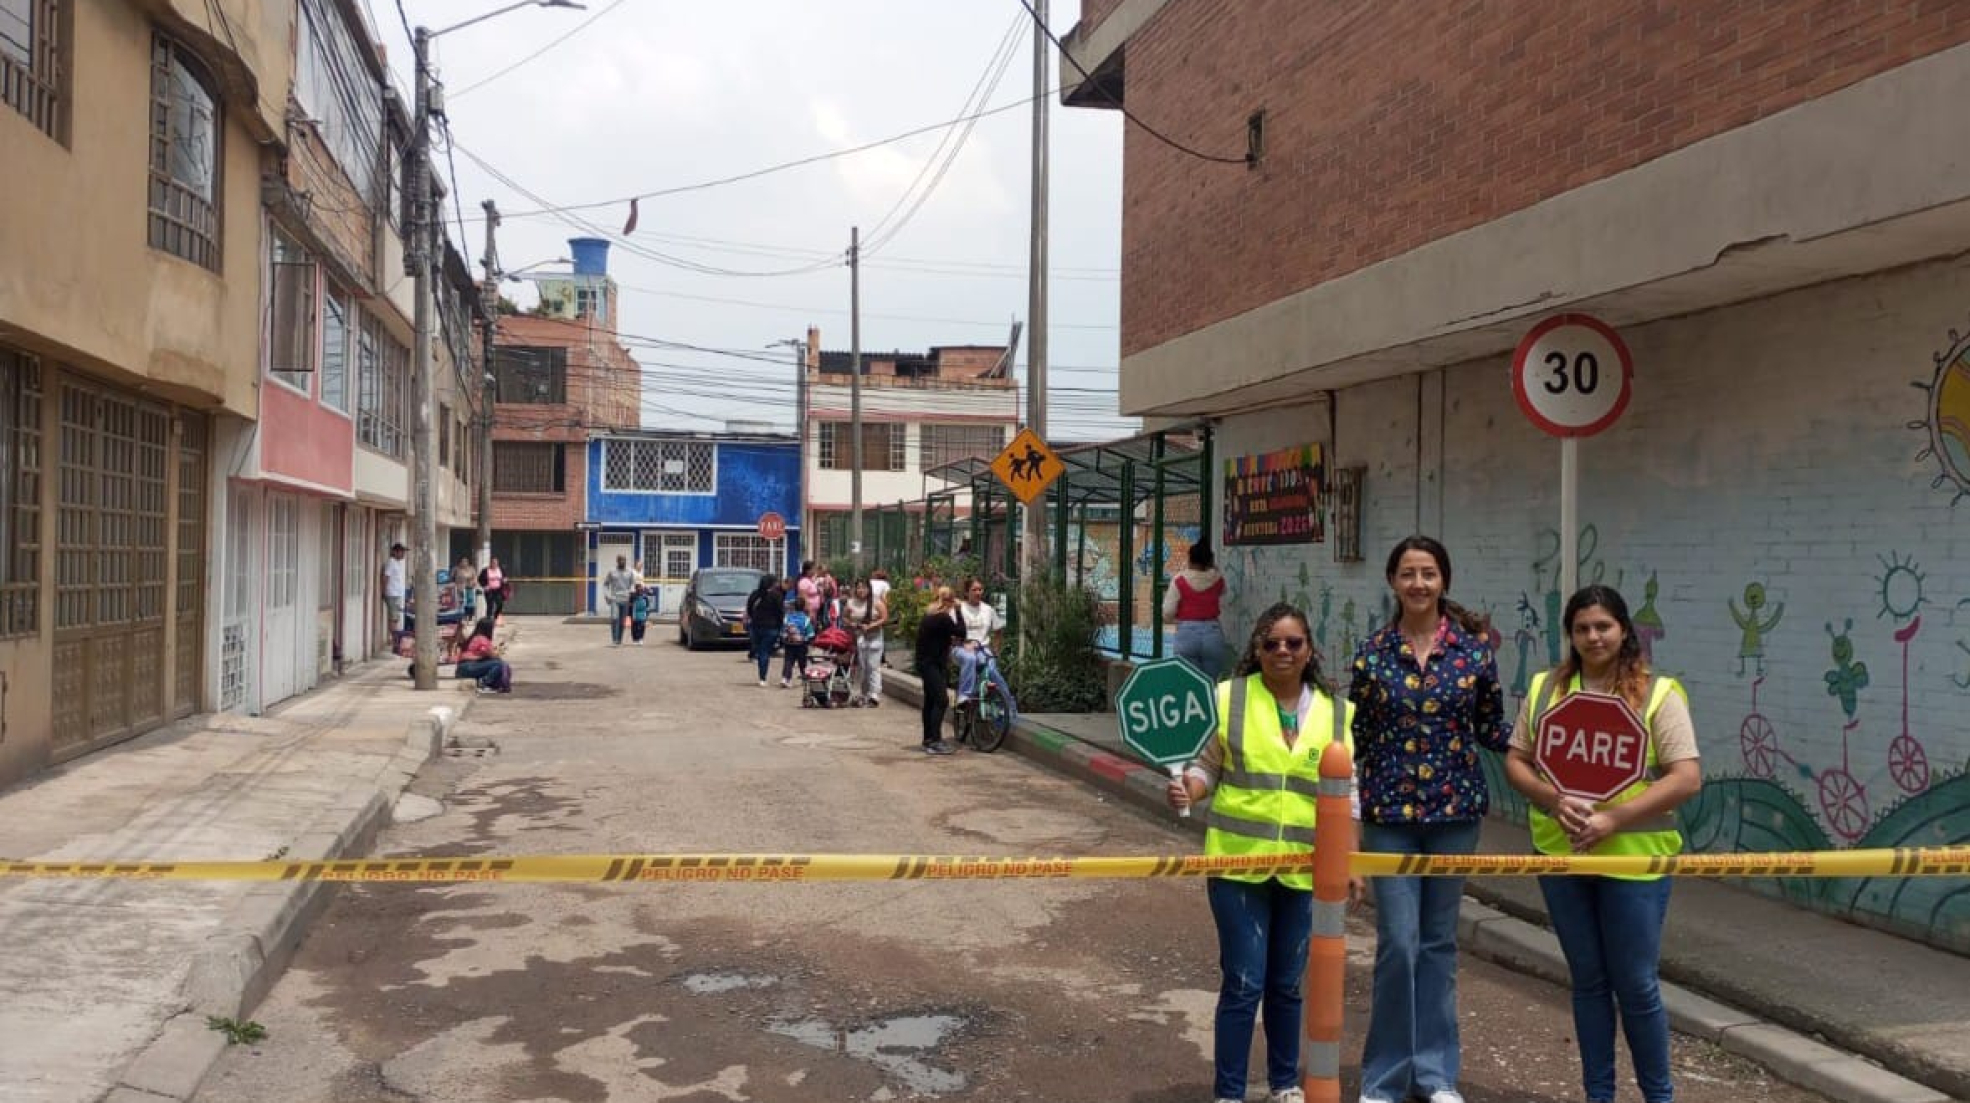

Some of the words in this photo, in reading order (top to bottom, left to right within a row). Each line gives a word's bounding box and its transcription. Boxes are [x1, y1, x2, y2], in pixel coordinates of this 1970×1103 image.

[1544, 351, 1598, 395] 30
[1129, 690, 1206, 733] SIGA
[1545, 725, 1635, 769] PARE
[642, 868, 721, 880] PELIGRO
[727, 868, 751, 879] NO
[758, 866, 804, 879] PASE
[926, 862, 998, 876] PELIGRO
[1003, 862, 1027, 875] NO
[1032, 861, 1072, 875] PASE
[1185, 855, 1251, 869] PELIGRO
[1256, 854, 1277, 867] NO
